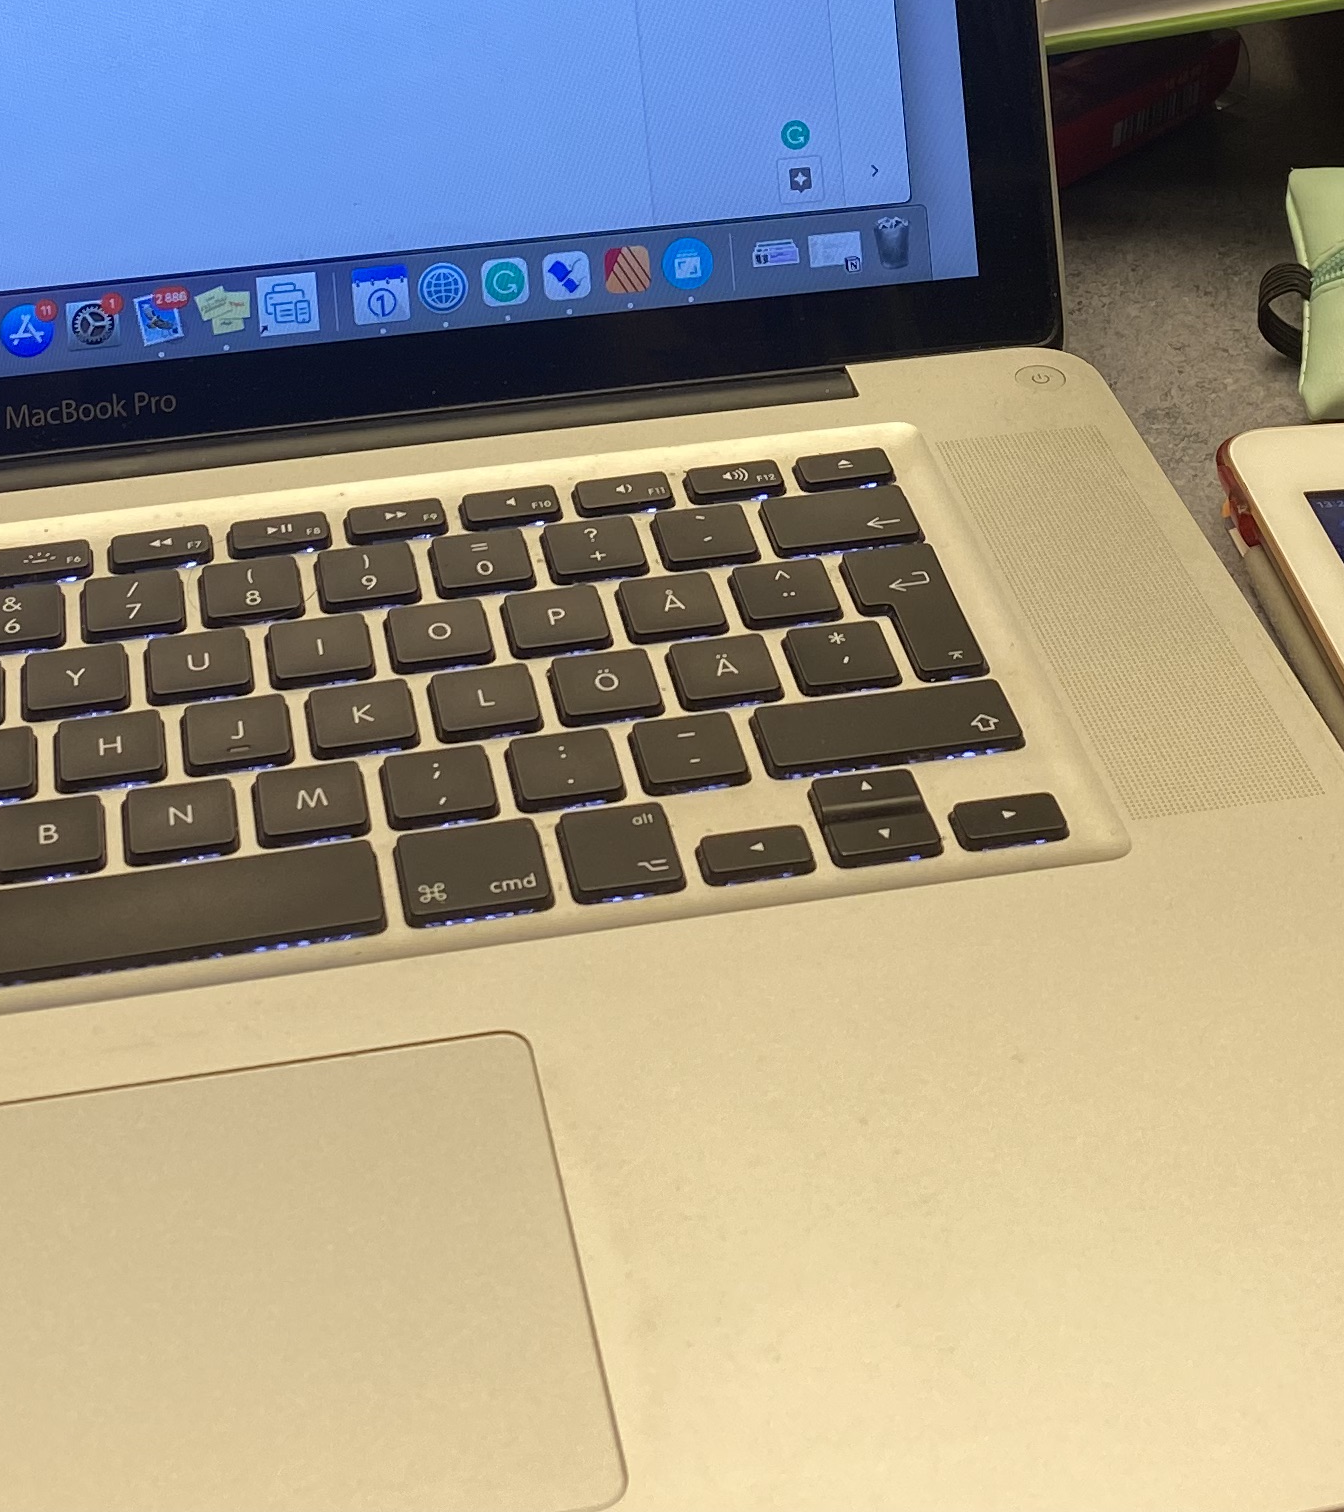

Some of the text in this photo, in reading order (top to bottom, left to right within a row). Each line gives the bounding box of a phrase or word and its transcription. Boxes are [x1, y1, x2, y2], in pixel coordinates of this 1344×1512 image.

[5, 391, 177, 429] MacBook Pro
[664, 589, 686, 613] Å
[548, 608, 565, 625] P
[188, 653, 209, 670] U
[717, 654, 738, 676] Ä
[66, 668, 85, 686] Y
[594, 669, 619, 691] Ö
[478, 689, 495, 706] L
[353, 705, 375, 723] K
[231, 721, 244, 739] J
[98, 736, 123, 756] H
[296, 789, 328, 809] M
[168, 806, 193, 825] N
[632, 812, 653, 826] alt
[39, 825, 58, 844] B
[490, 874, 537, 893] cmd
